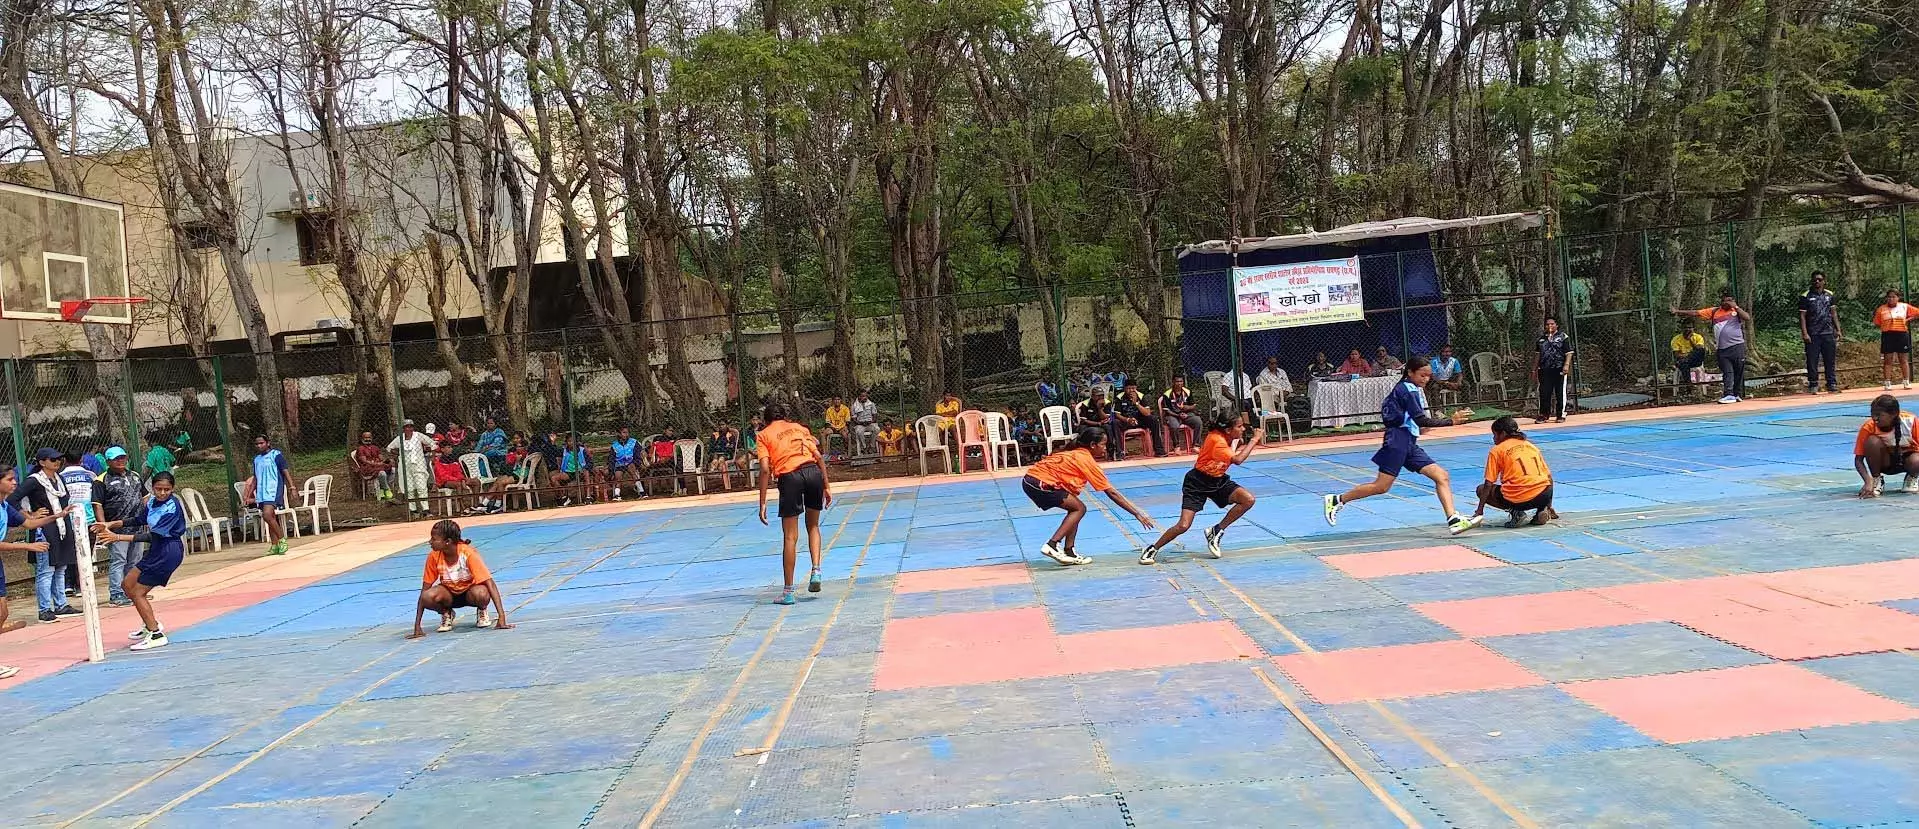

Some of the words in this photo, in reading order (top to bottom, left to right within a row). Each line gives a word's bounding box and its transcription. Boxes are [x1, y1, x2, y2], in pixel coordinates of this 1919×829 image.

[1278, 289, 1321, 307] खो-खो
[791, 438, 804, 456] 7
[1515, 456, 1542, 476] 11
